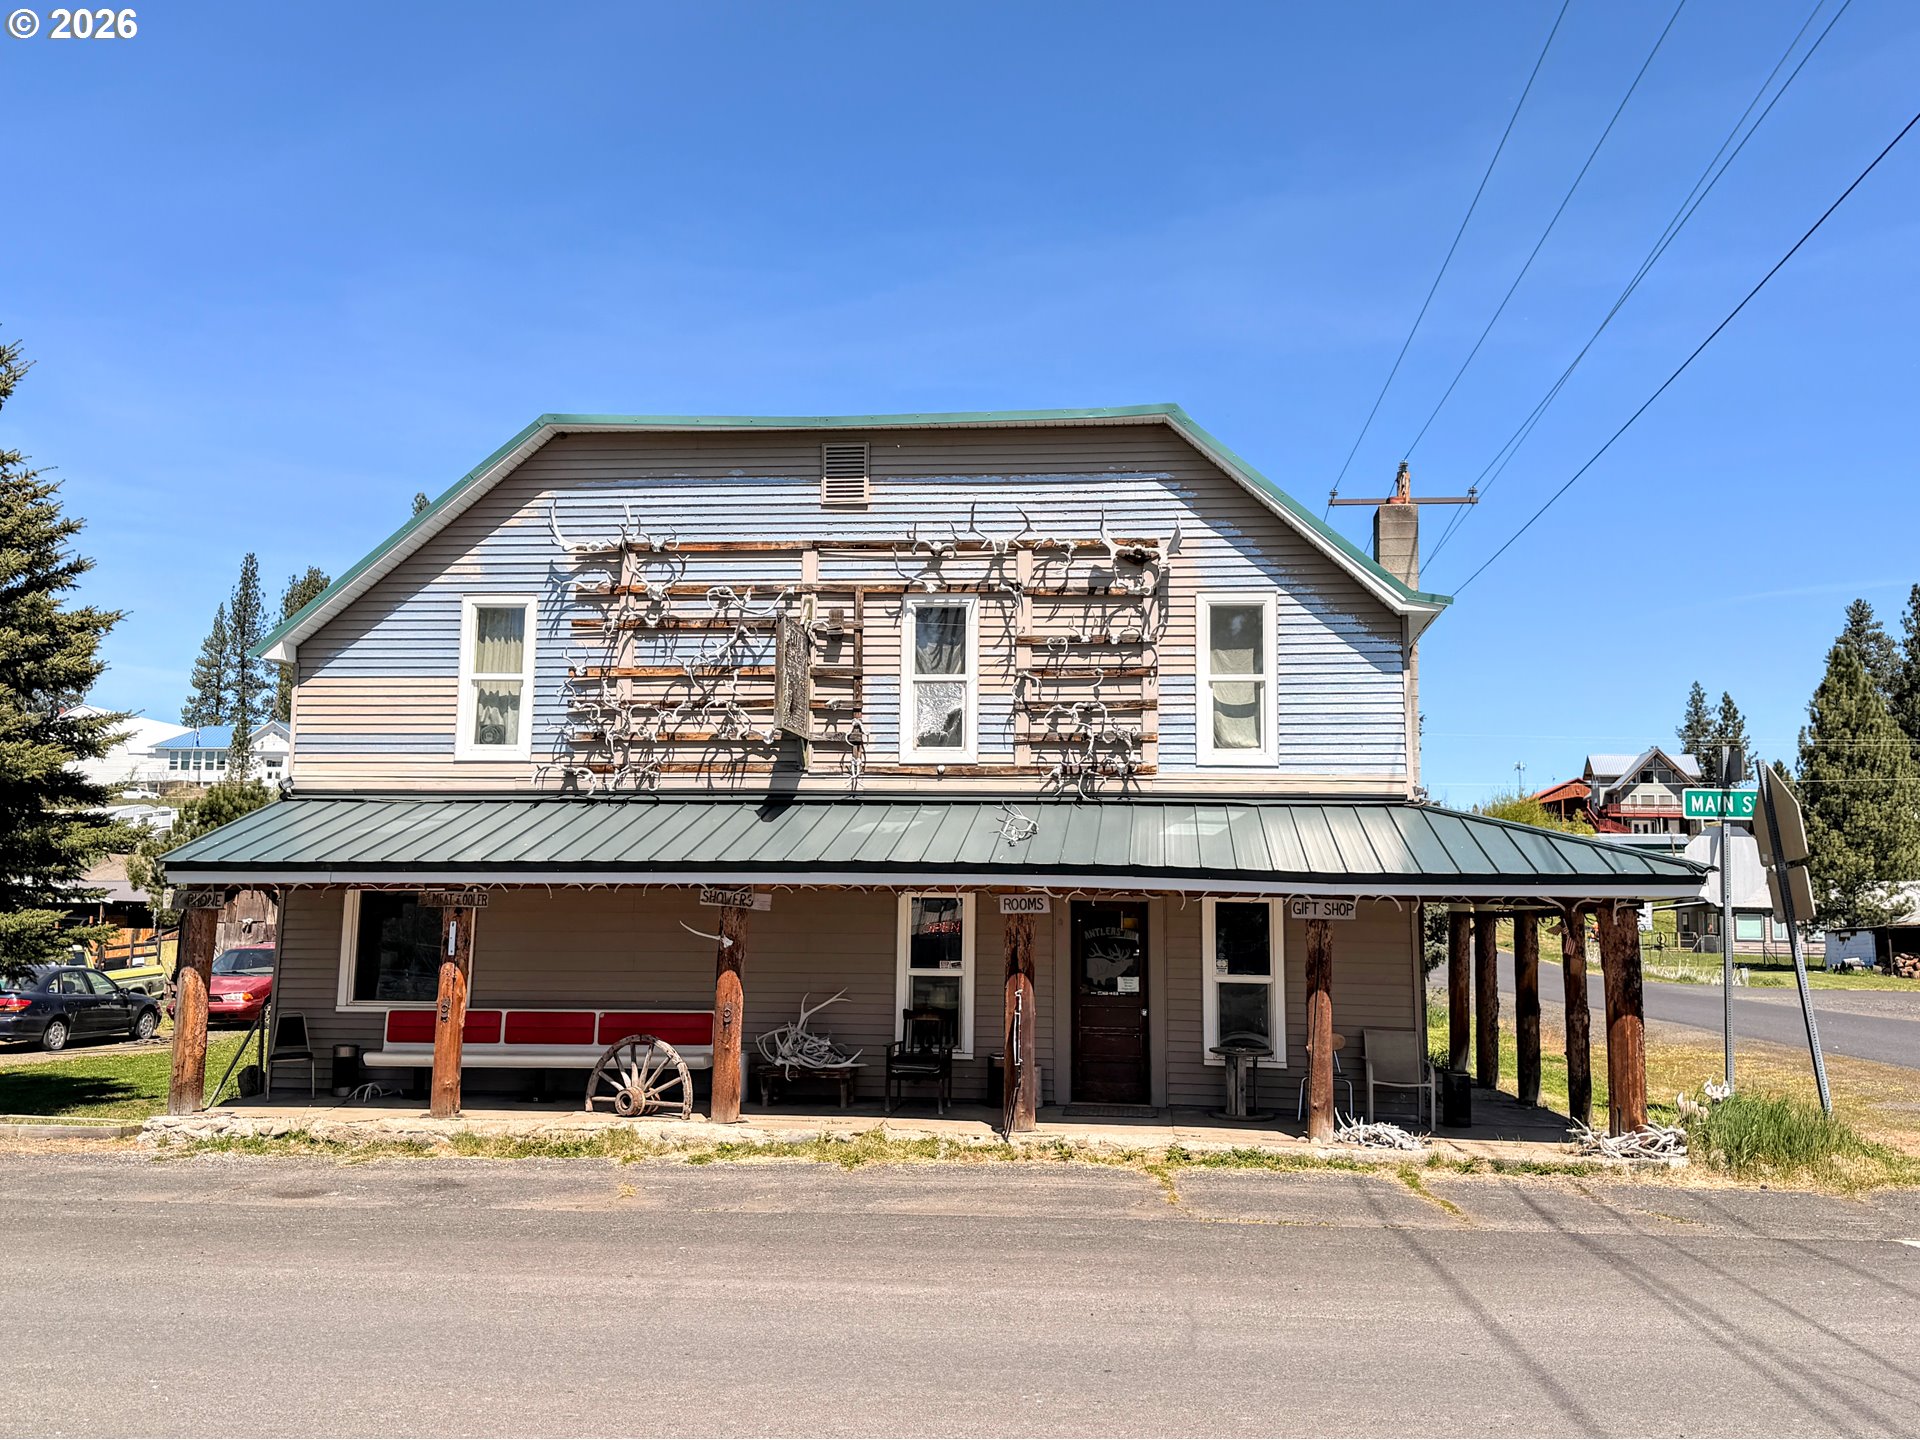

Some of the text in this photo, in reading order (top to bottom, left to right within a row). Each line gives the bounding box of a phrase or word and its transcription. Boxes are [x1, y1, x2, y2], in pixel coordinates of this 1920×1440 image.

[1691, 795, 1758, 813] MAIN S
[188, 892, 223, 908] PHONE
[431, 892, 455, 906] MEAT
[701, 889, 754, 908] SHOWERS
[1003, 897, 1044, 911] ROOMS
[1292, 901, 1355, 916] GIFT SHOP
